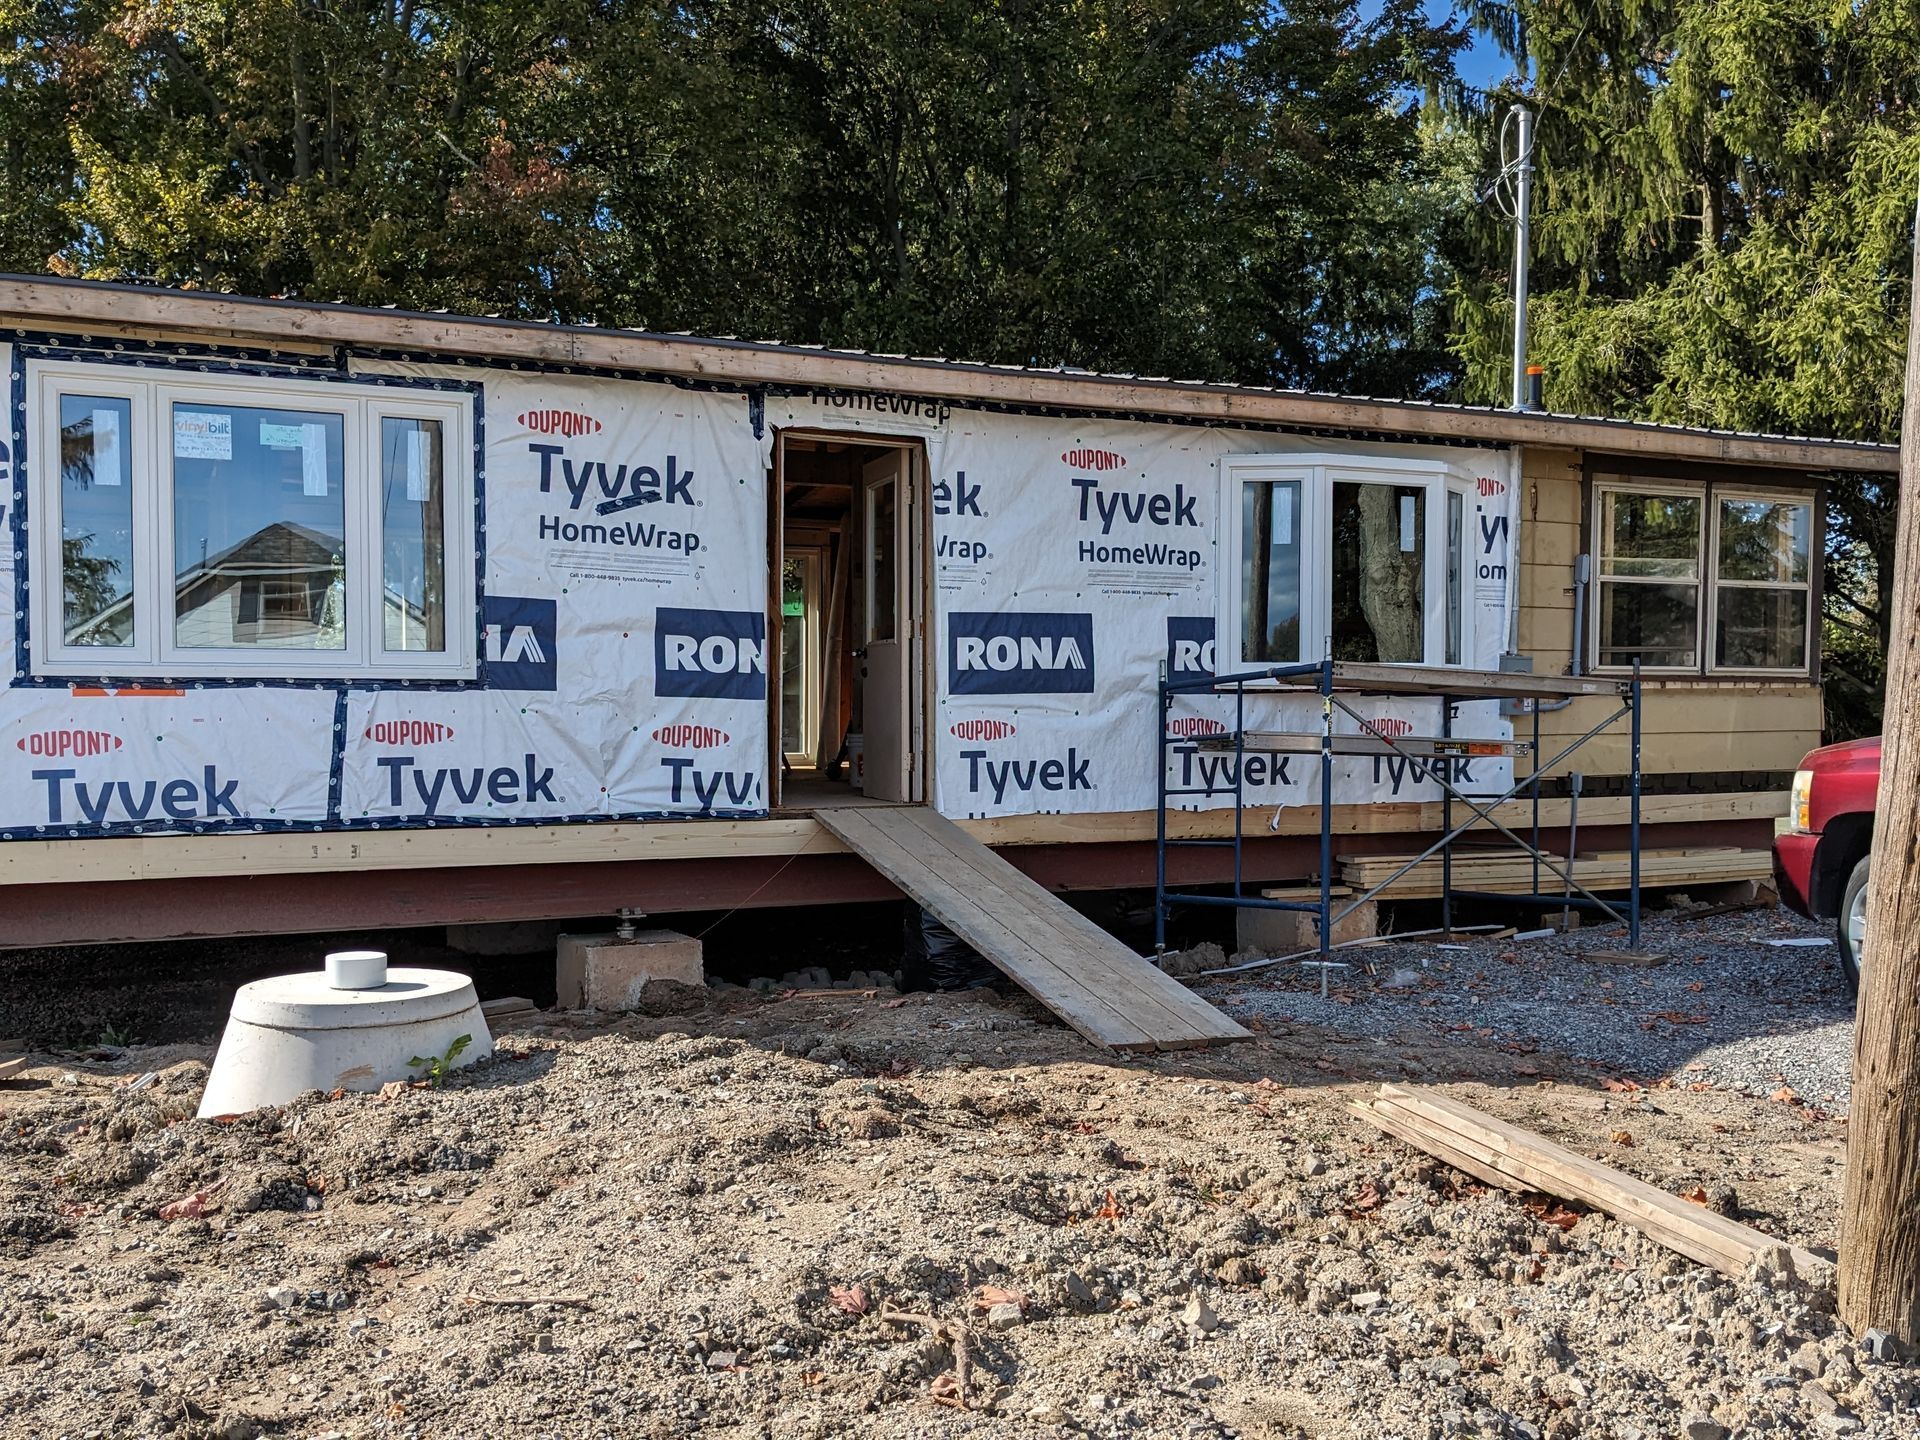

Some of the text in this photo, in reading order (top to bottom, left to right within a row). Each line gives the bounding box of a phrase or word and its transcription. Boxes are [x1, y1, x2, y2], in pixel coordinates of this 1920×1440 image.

[176, 419, 230, 436] vinylbilt
[528, 410, 593, 437] DUPONT
[1070, 449, 1119, 471] DUPONT
[528, 443, 695, 510] Tyvek
[1071, 478, 1199, 535] Tyvek
[539, 515, 700, 556] HomeWrap
[1079, 540, 1200, 571] HomeWrap
[956, 636, 1087, 671] RONA
[375, 720, 444, 745] DUPONT
[661, 725, 722, 749] DUPONT
[957, 720, 1009, 741] DUPONT
[1172, 718, 1219, 737] DUPONT
[1365, 718, 1407, 737] DUPONT
[30, 729, 111, 758] DUPONT
[378, 753, 557, 815] Tyvek
[661, 757, 761, 811] Tyv
[960, 748, 1092, 805] Tyvek
[1173, 746, 1291, 798] Tyvek
[32, 764, 240, 824] Tyvek
